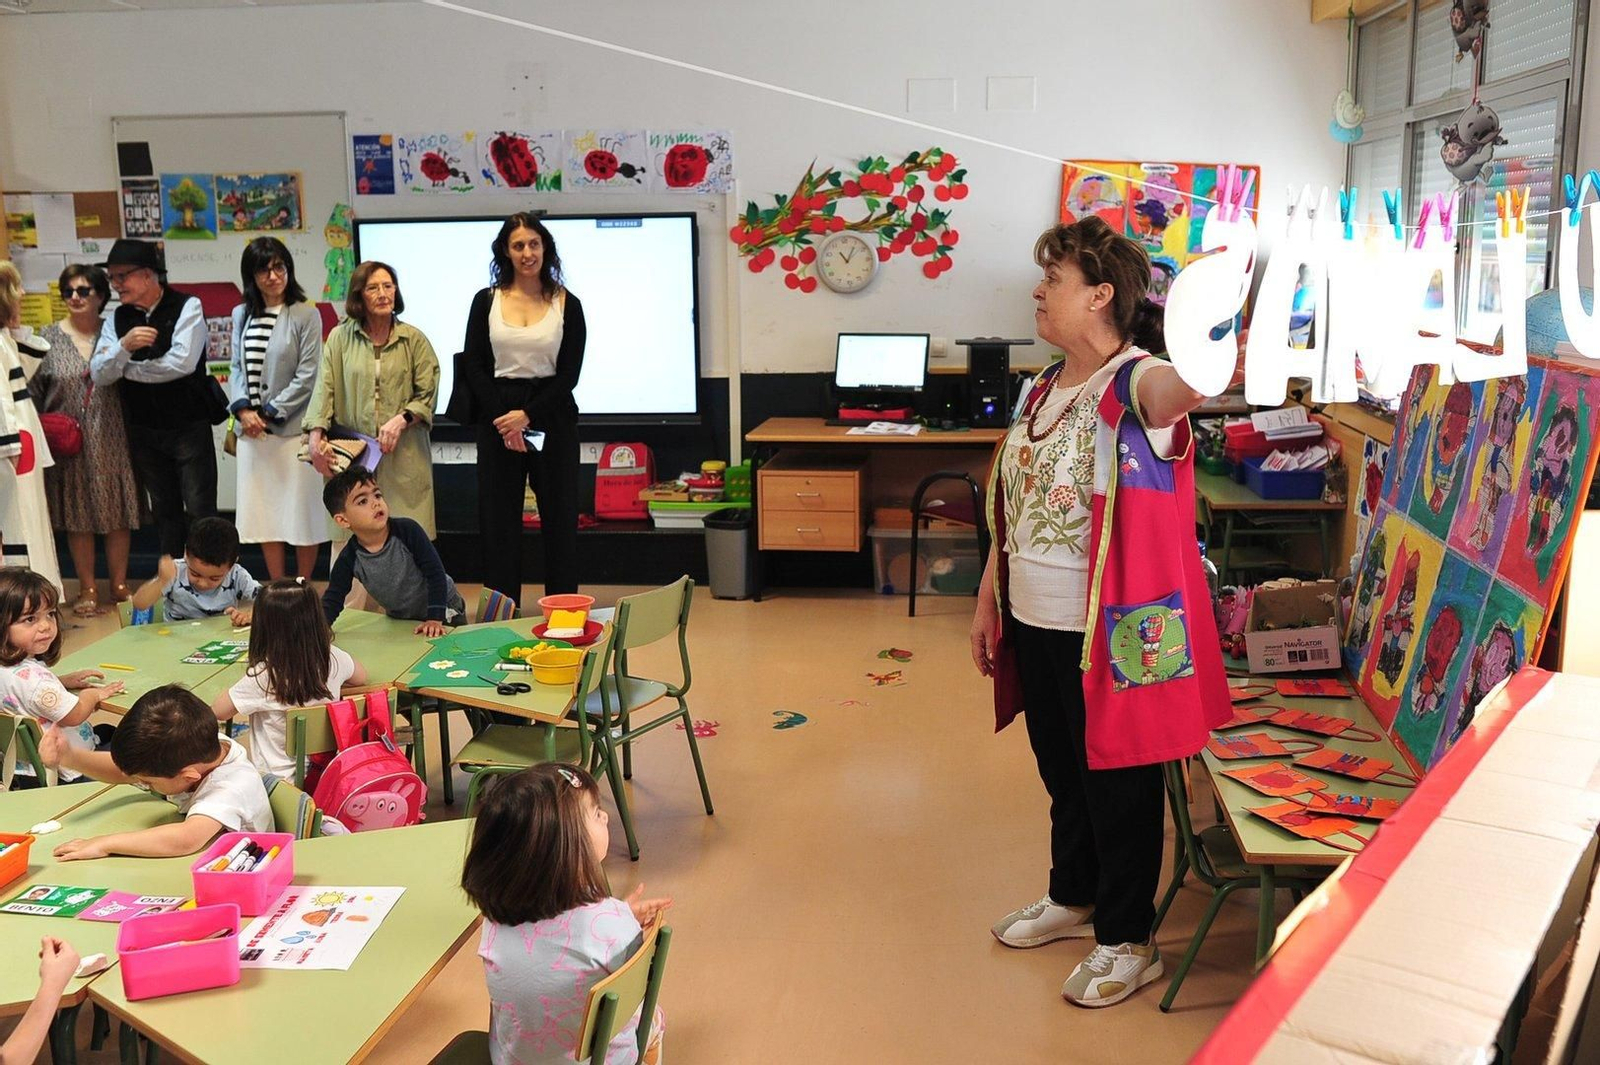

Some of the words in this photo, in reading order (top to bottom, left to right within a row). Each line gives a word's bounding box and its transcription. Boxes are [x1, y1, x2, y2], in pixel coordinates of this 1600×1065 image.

[436, 447, 444, 459] 1
[455, 446, 463, 460] 2
[590, 446, 597, 459] 9
[1265, 658, 1275, 666] 80
[9, 904, 54, 912] BENTO
